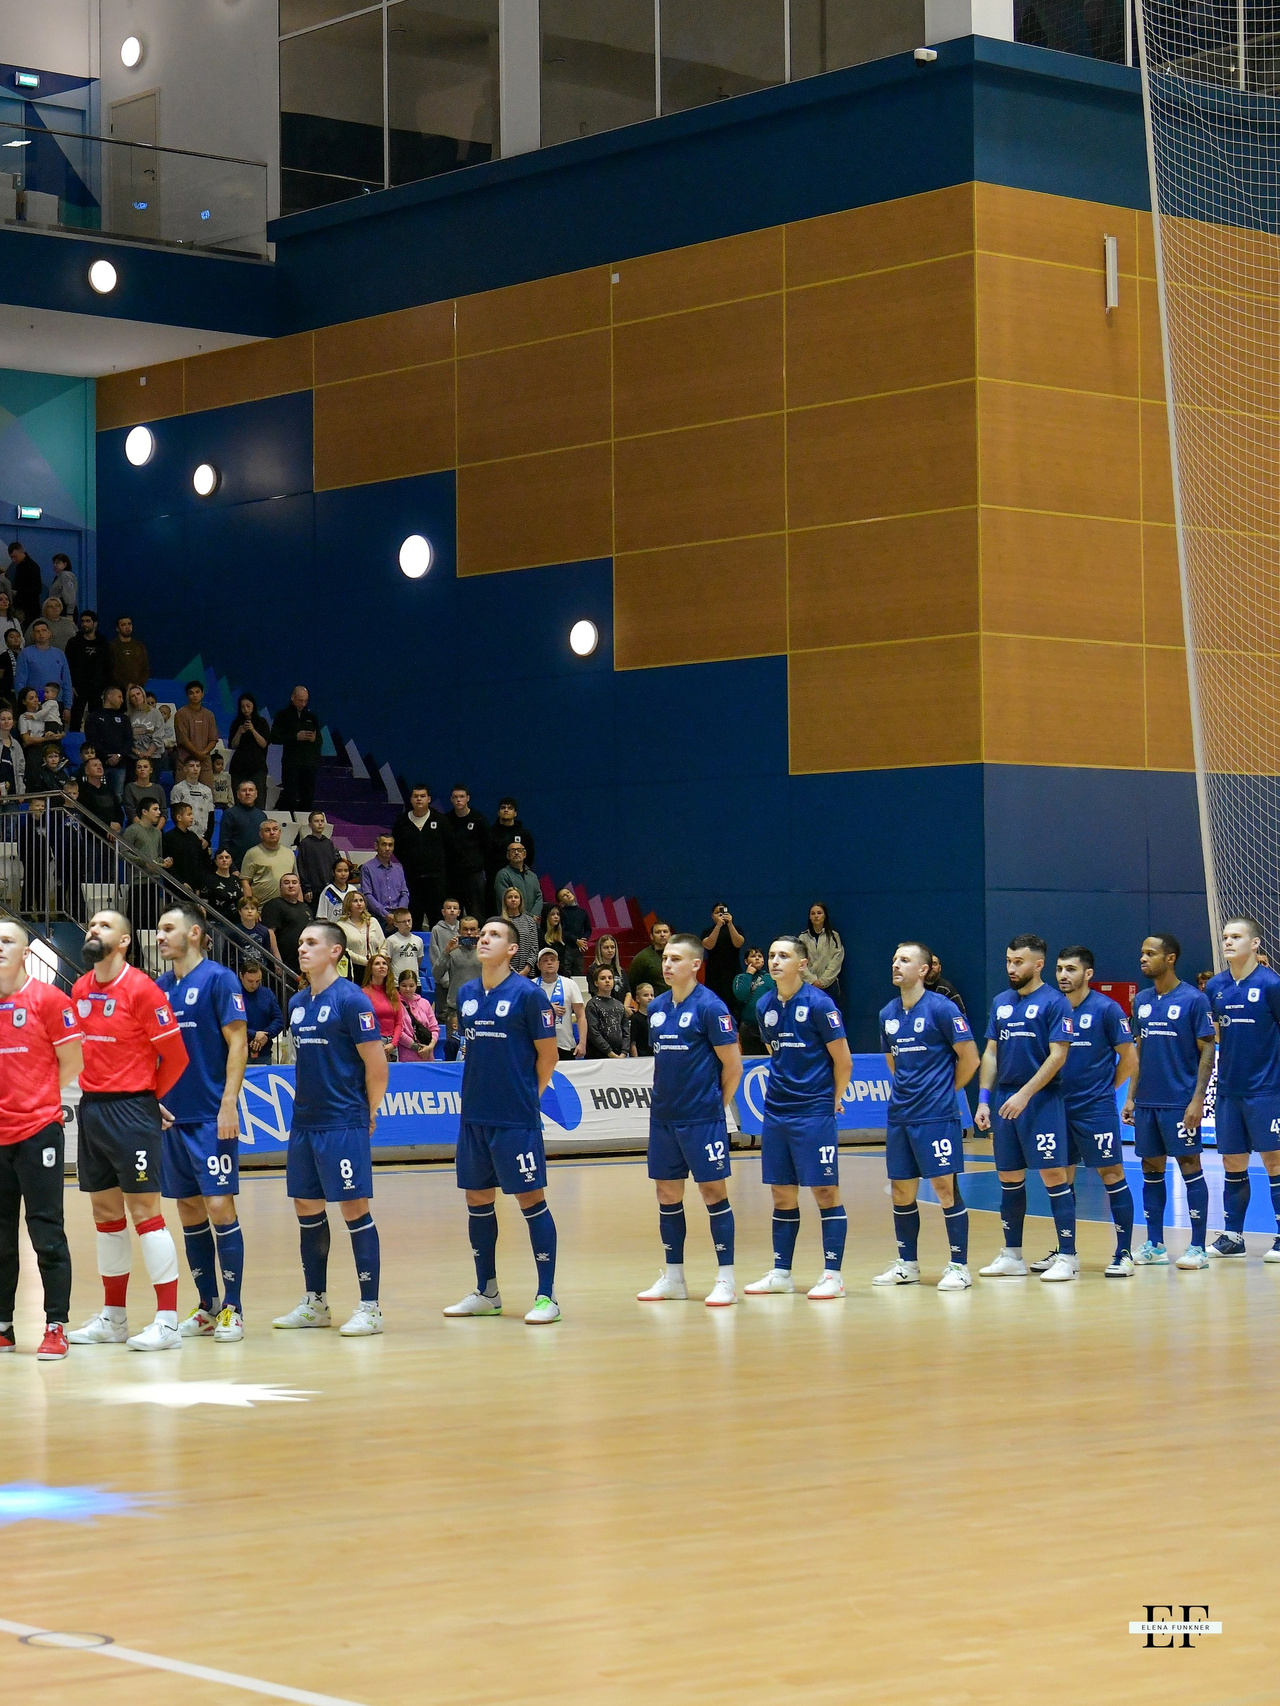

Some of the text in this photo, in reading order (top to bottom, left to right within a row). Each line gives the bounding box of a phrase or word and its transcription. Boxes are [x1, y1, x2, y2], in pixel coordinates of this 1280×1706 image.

[932, 1138, 952, 1158] 19
[1035, 1133, 1057, 1151] 23
[1094, 1132, 1114, 1150] 77
[135, 1151, 148, 1171] 3
[704, 1141, 725, 1162] 12
[818, 1146, 836, 1164] 17
[206, 1154, 233, 1176] 90
[339, 1159, 354, 1179] 8
[515, 1152, 537, 1173] 11
